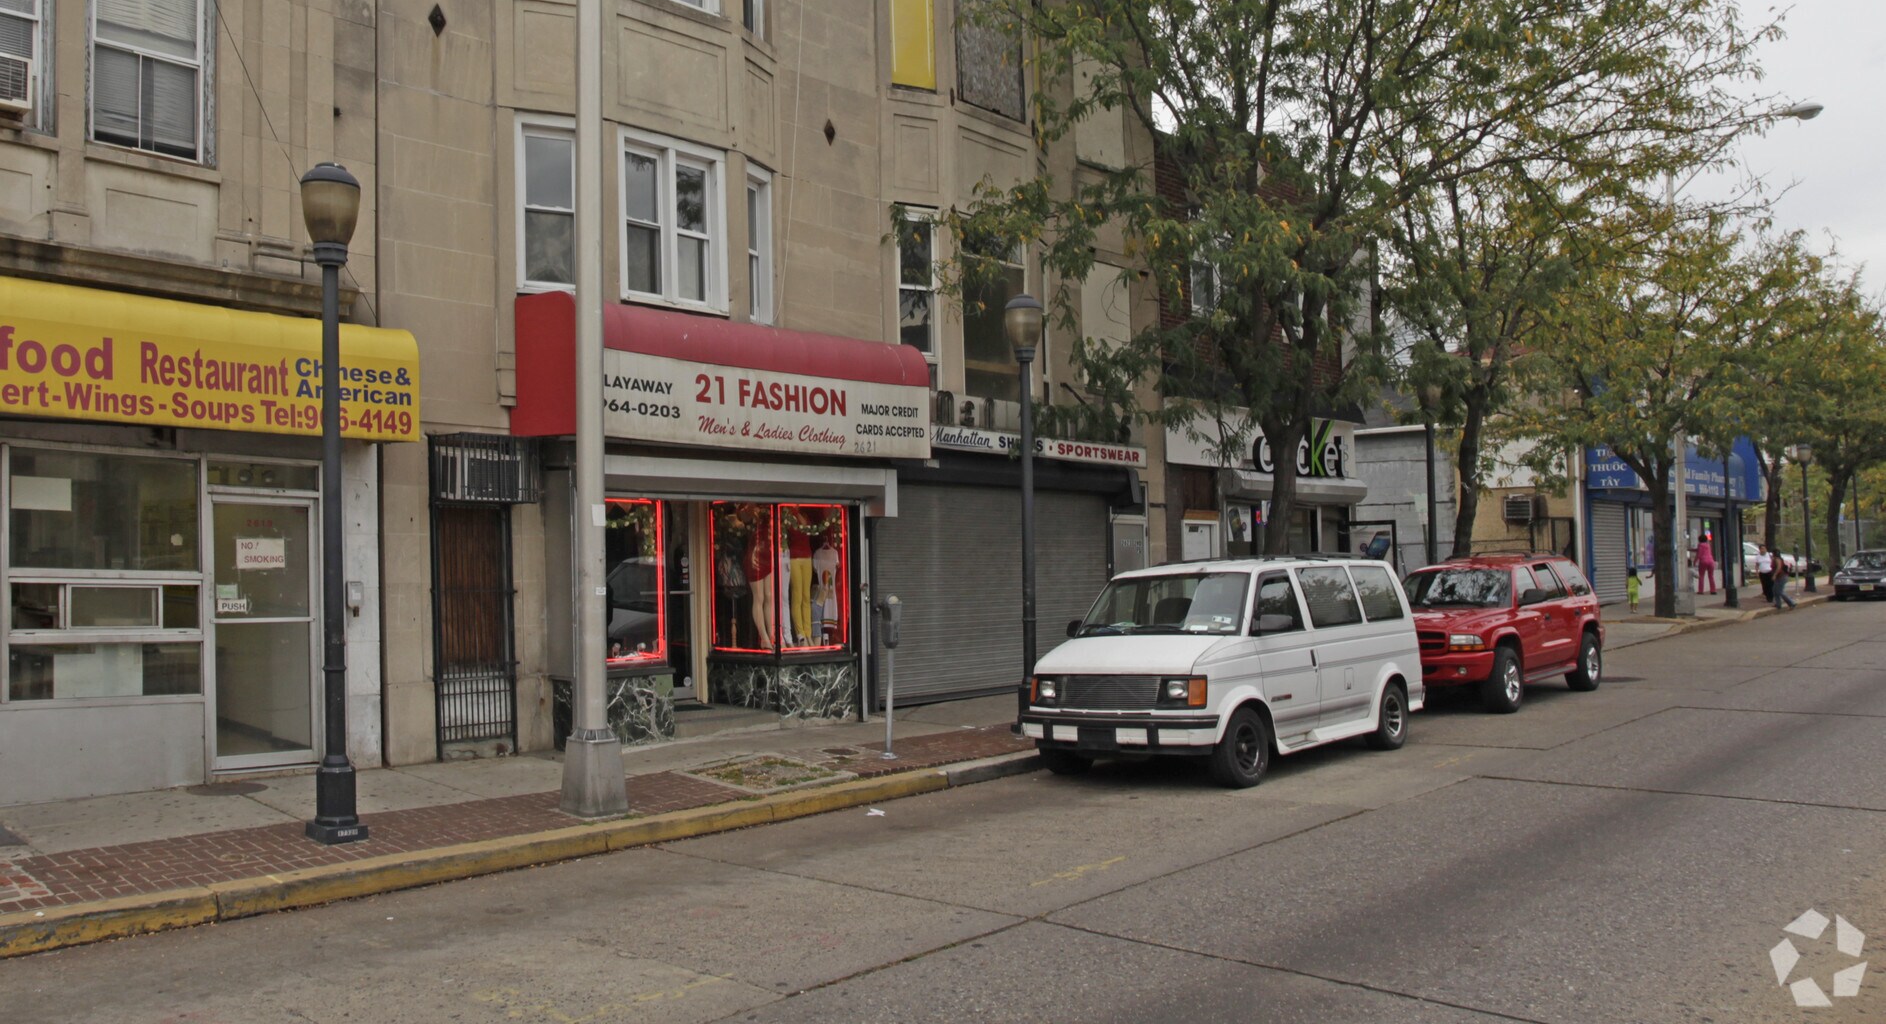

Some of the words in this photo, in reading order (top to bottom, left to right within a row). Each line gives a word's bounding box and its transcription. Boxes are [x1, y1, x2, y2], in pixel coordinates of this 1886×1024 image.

[140, 340, 289, 397] Restaurant
[604, 373, 673, 395] LAYAWAY
[695, 373, 725, 405] 21
[738, 378, 847, 417] FASHION
[861, 403, 890, 416] MAJOR
[891, 405, 919, 418] CREDIT
[698, 415, 736, 436] Men's
[741, 420, 750, 437] &
[753, 422, 794, 440] Ladies
[798, 424, 846, 450] Clothing
[856, 423, 884, 436] CARDS
[885, 425, 925, 438] ACCEPTED
[931, 427, 993, 449] Manhattan
[854, 440, 876, 453] 2621
[1057, 443, 1140, 463] SPORTSWEAR
[1691, 469, 1710, 484] Family
[244, 555, 284, 564] SMOKING
[221, 602, 245, 611] PUSH
